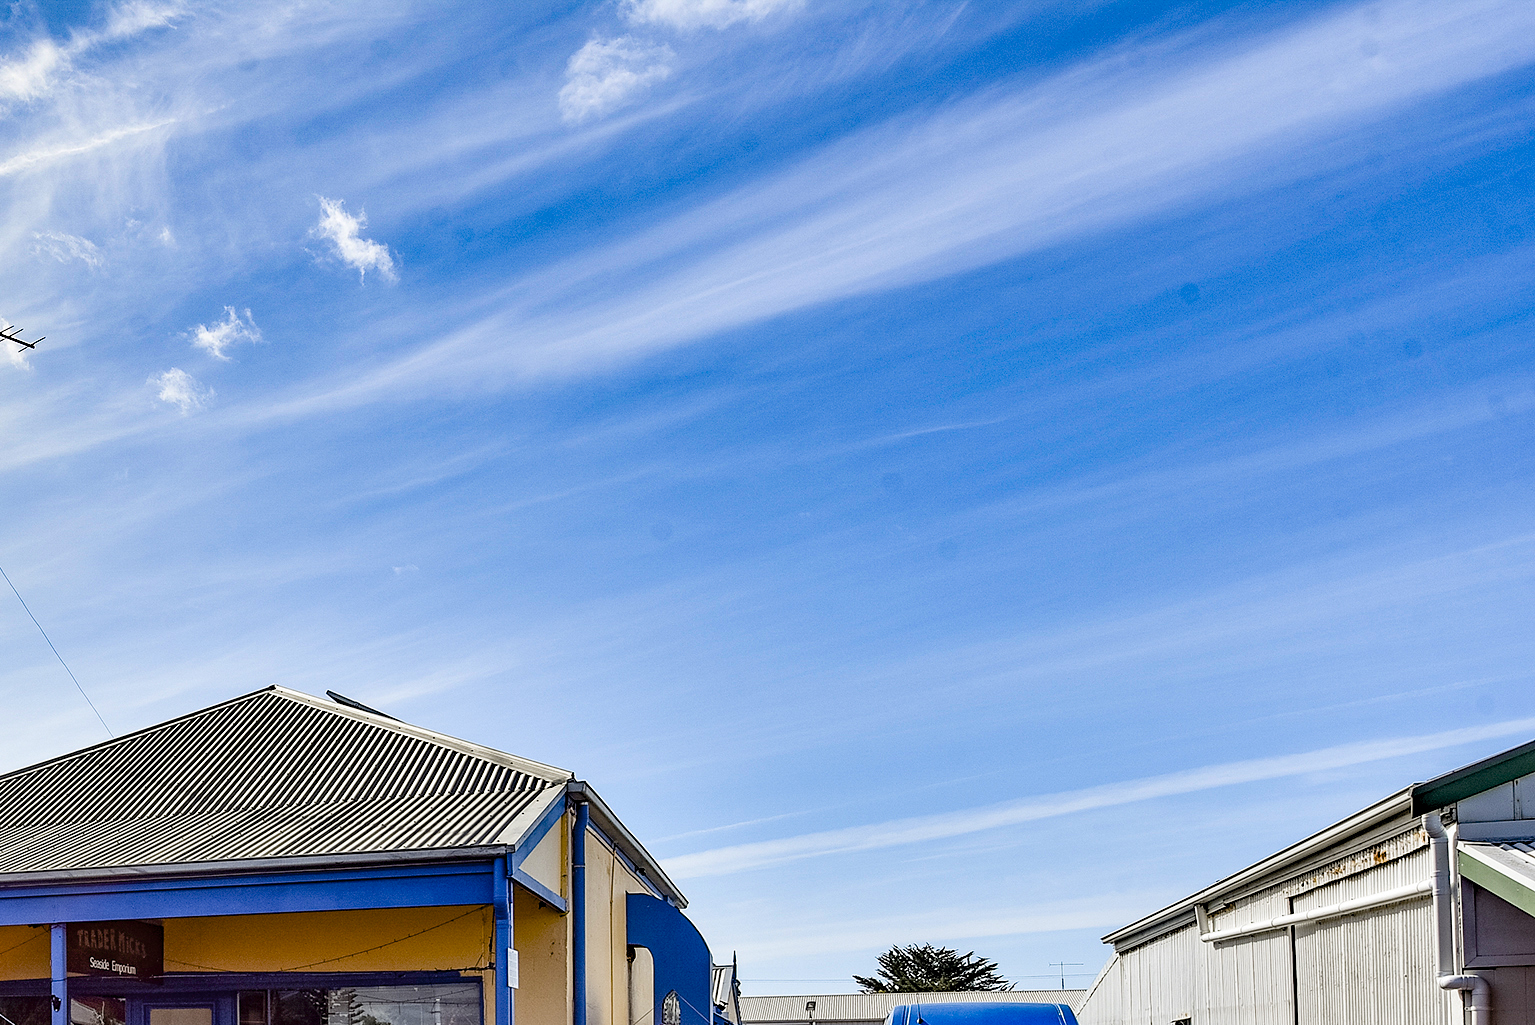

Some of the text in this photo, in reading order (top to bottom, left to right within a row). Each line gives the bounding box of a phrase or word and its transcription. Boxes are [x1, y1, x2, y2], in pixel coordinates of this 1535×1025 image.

[76, 928, 117, 951] TRADER
[89, 956, 137, 976] Seaside Emporium
